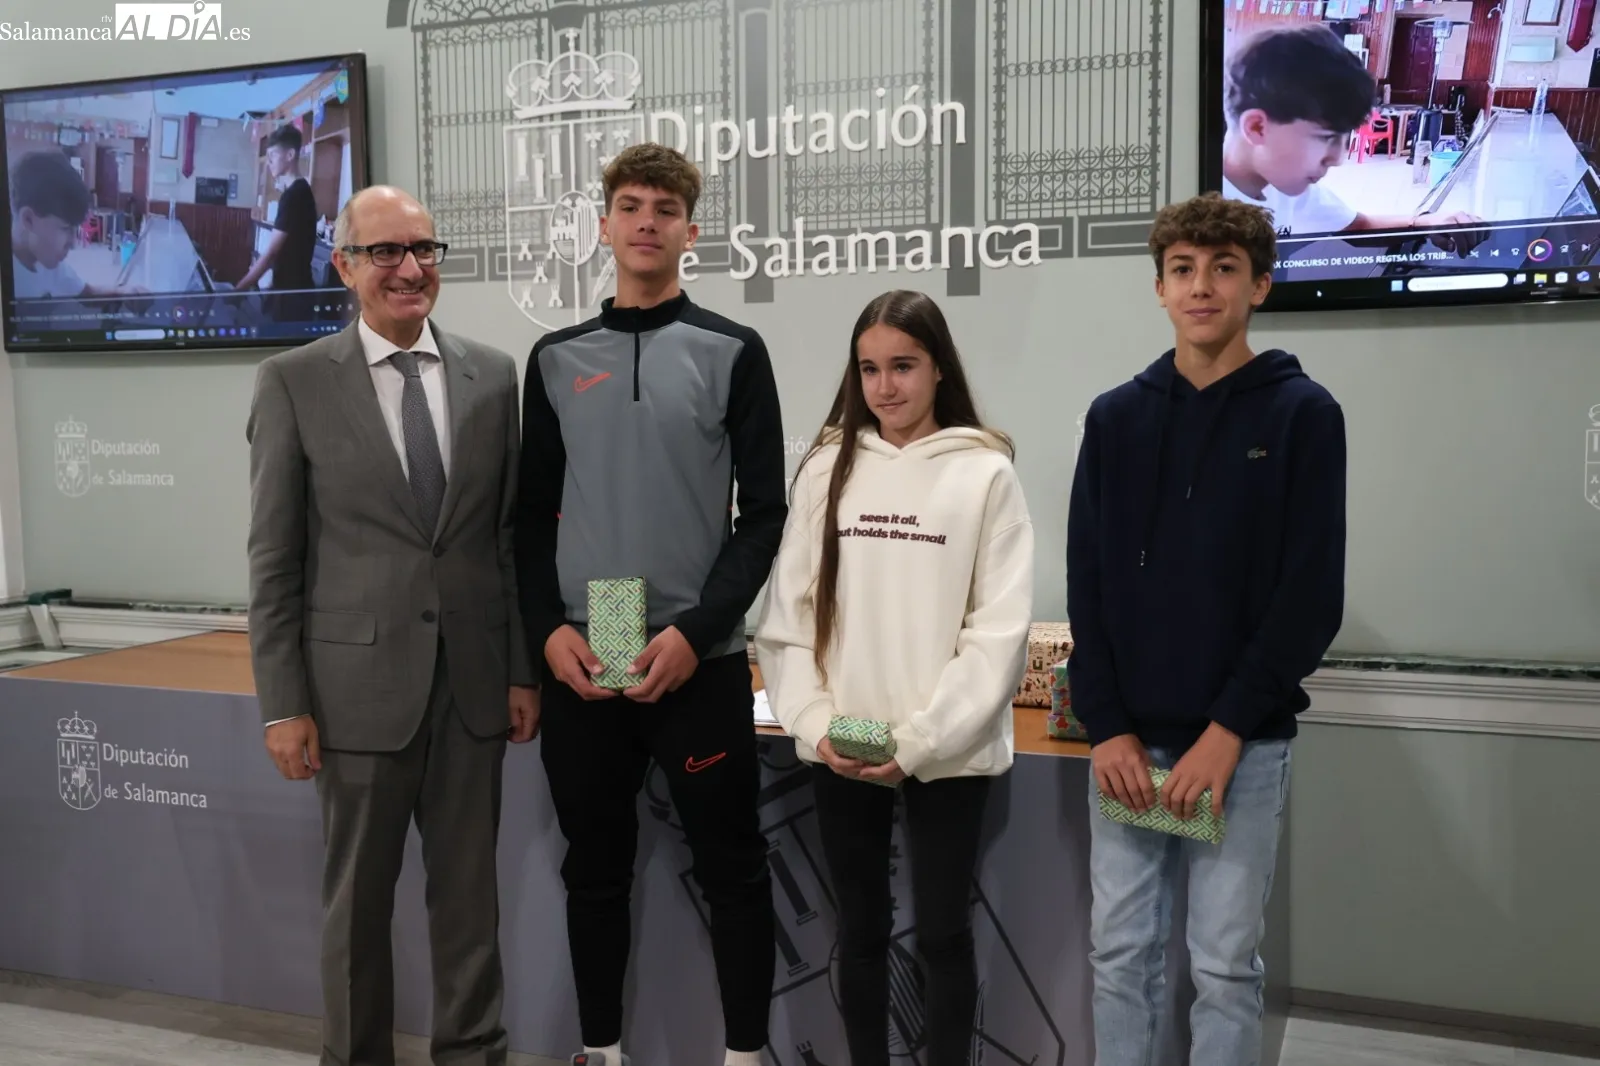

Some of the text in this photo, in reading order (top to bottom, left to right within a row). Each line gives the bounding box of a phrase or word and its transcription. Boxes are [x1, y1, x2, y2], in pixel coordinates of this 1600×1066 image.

[649, 85, 967, 177] Diputación
[678, 217, 1043, 282] e Salamanca
[1283, 258, 1329, 269] CONCURSO
[1330, 257, 1342, 266] DE
[1343, 255, 1374, 265] VIDEOS
[1376, 253, 1408, 264] REGTSA
[1409, 253, 1426, 262] LOS
[91, 439, 160, 458] Diputación
[92, 469, 174, 486] de Salamanca
[859, 513, 920, 527] sees it all,
[853, 527, 889, 539] holds
[889, 529, 910, 540] the
[910, 532, 947, 545] small
[102, 743, 189, 769] Diputación
[104, 781, 208, 809] de Salamanca
